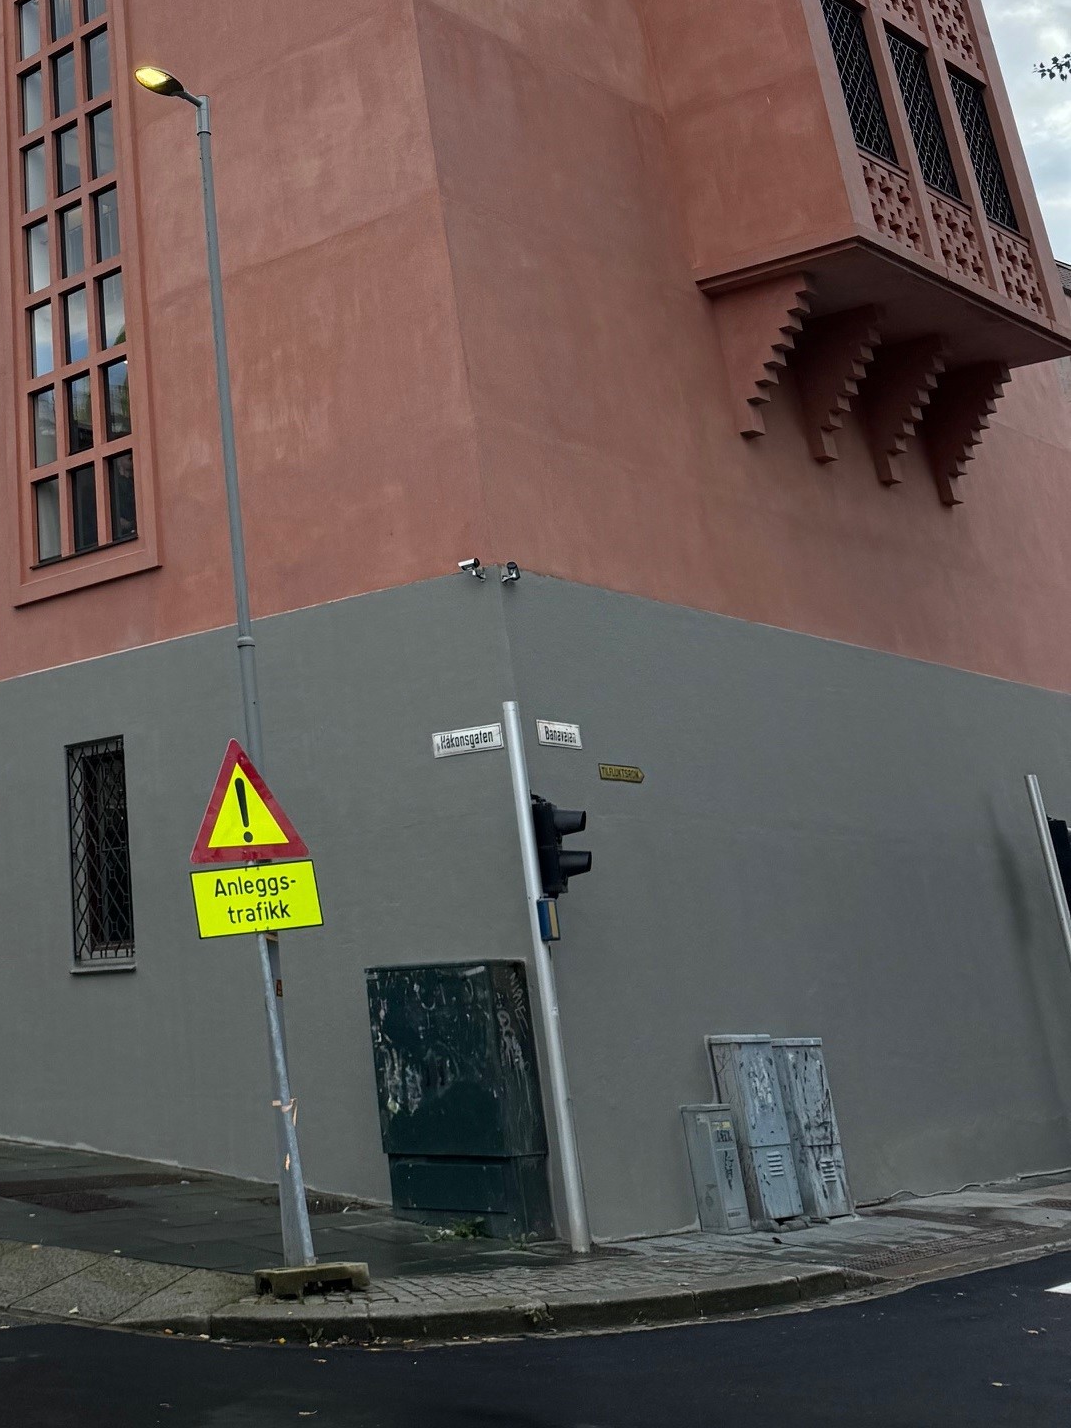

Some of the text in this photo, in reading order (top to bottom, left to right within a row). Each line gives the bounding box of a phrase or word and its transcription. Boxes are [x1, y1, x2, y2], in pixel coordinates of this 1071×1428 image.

[440, 730, 494, 750] Håkonsgaten
[544, 725, 576, 743] Baneveien
[214, 875, 297, 898] Anleggs-
[227, 899, 292, 924] trafikk
